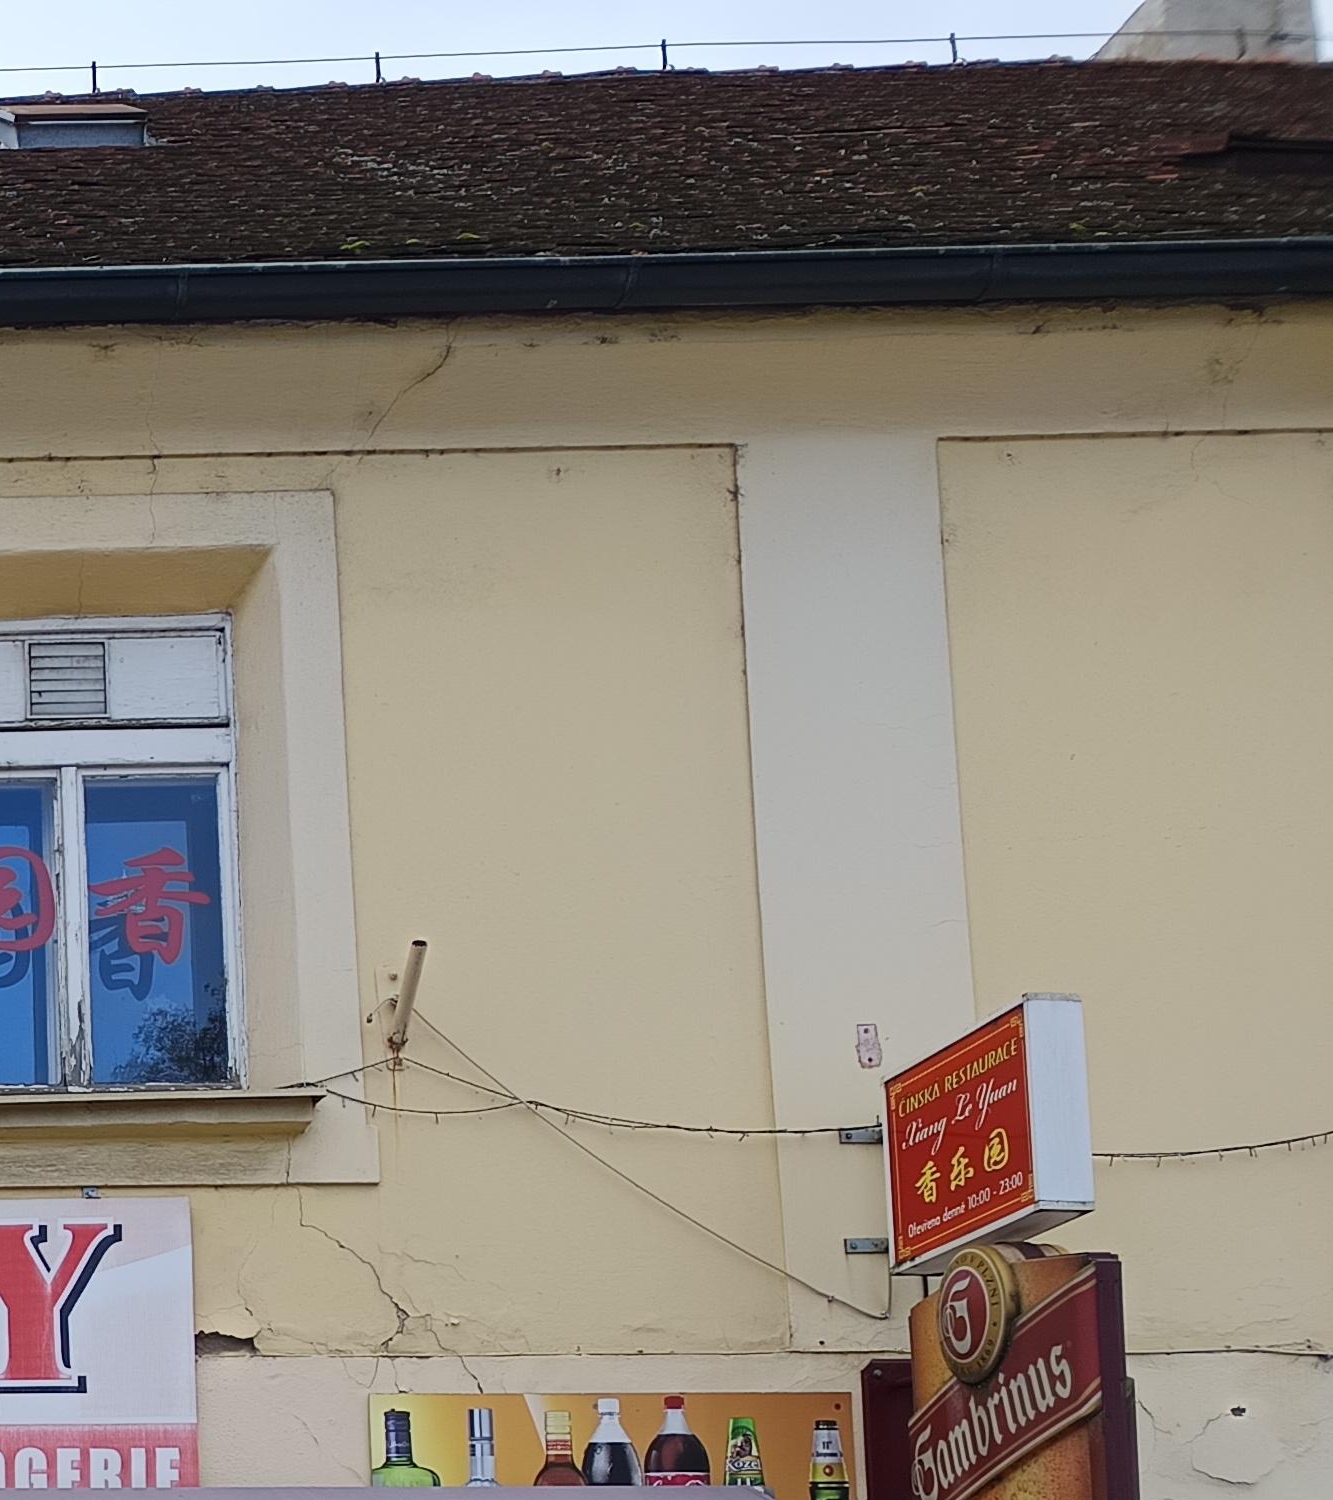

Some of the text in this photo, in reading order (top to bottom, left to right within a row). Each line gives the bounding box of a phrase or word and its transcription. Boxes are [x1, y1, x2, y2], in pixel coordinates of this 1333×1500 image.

[944, 1037, 1018, 1092] RESTAURACE
[902, 1079, 1018, 1156] Xiang Le Yuan
[968, 1187, 991, 1211] 10:00
[999, 1171, 1023, 1194] 23:00
